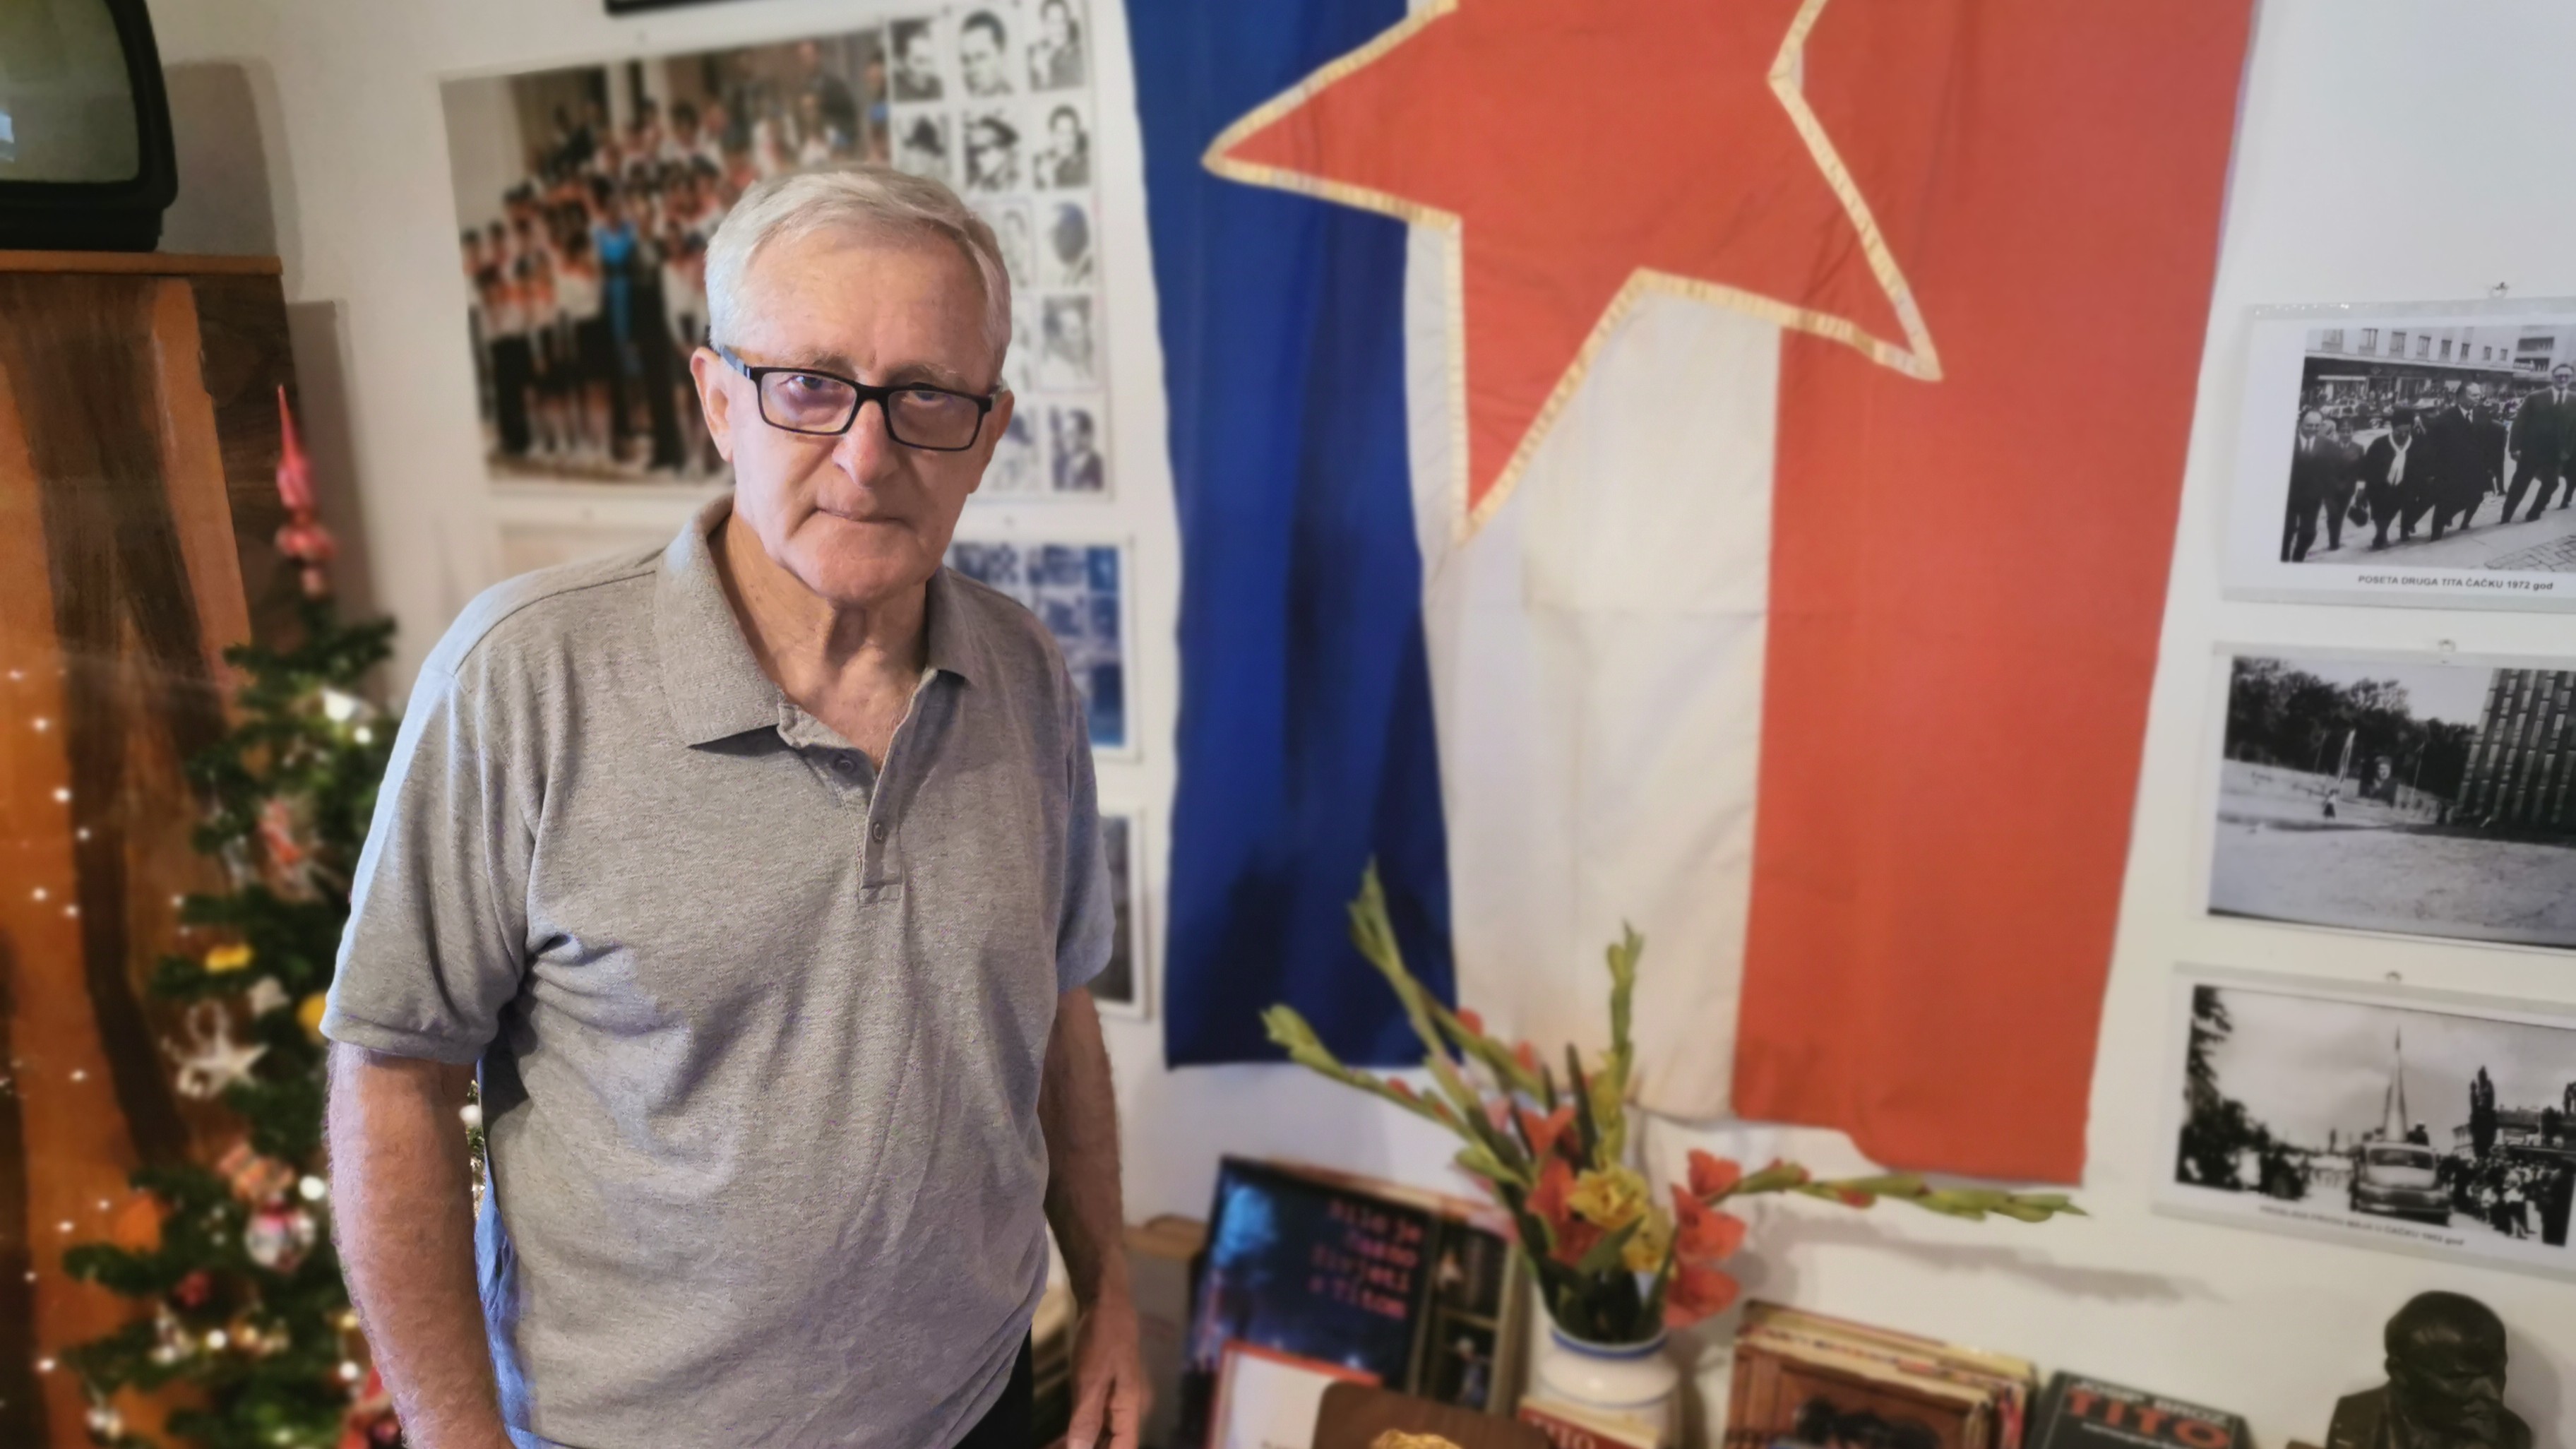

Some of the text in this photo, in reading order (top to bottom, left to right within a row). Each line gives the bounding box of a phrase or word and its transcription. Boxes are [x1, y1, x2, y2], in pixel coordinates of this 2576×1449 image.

[2358, 575, 2553, 592] POSETA DRUGA TITA ČAČKU 1972 god
[2066, 1386, 2232, 1448] TITO
